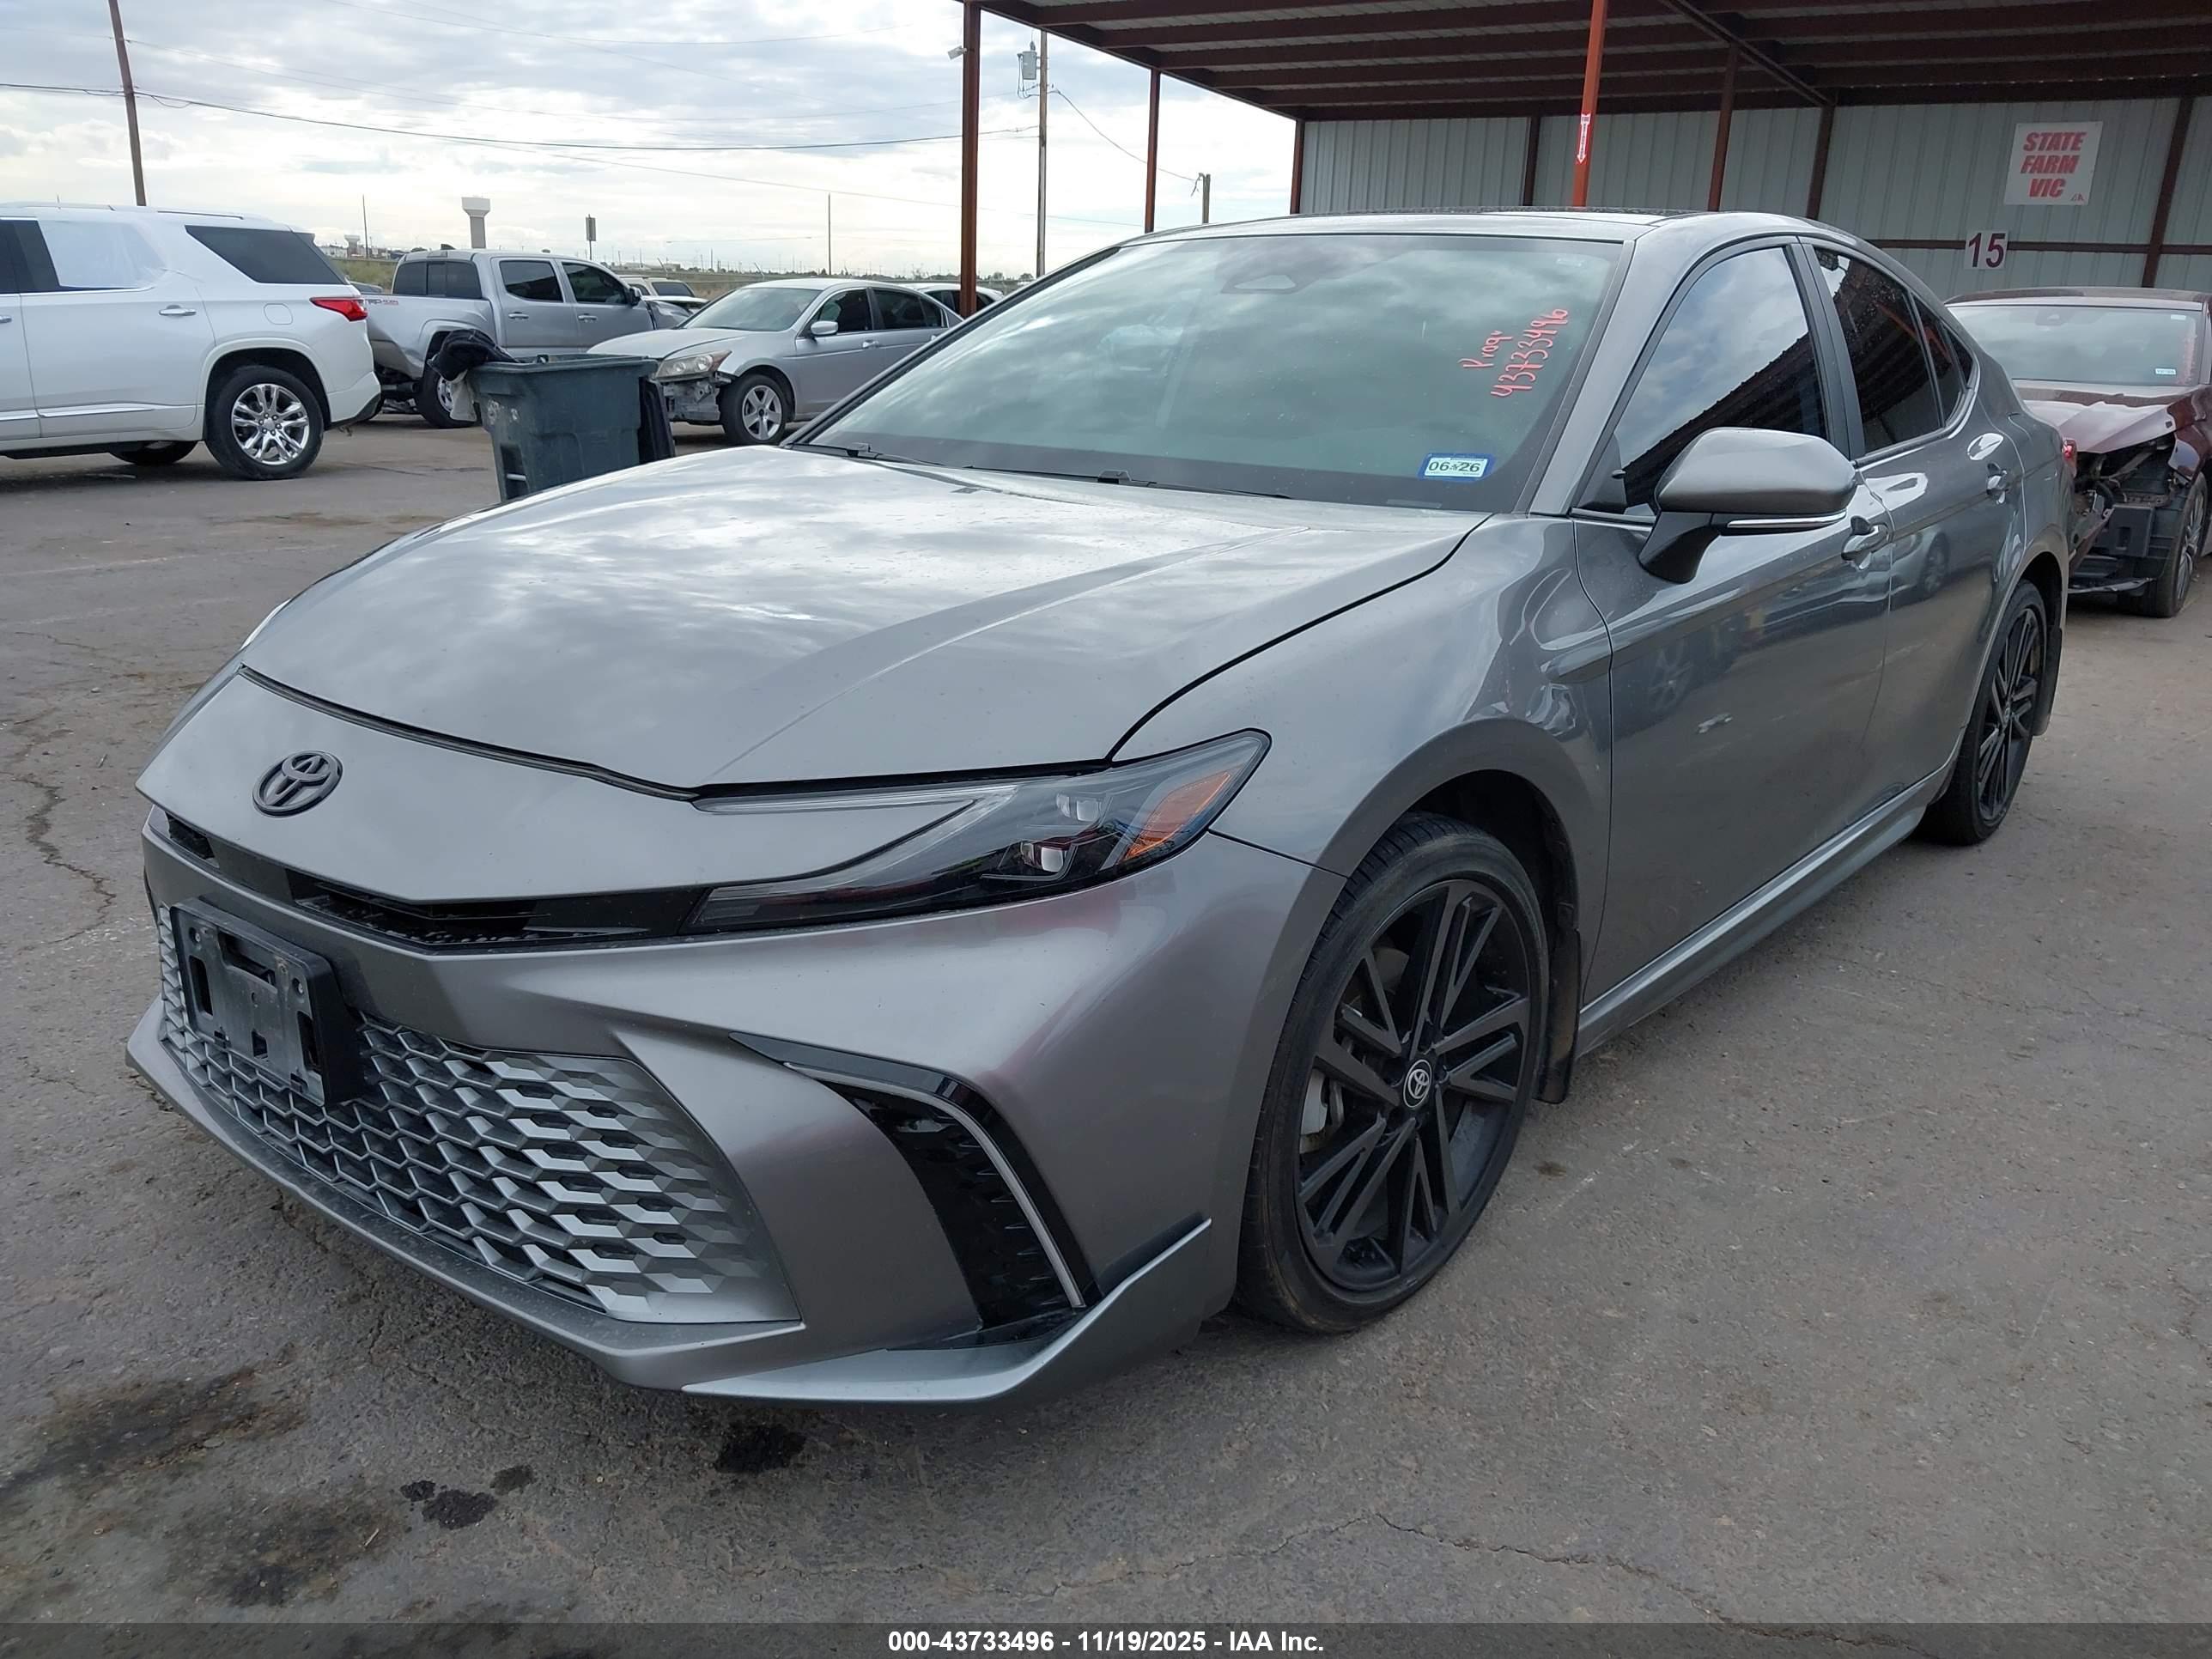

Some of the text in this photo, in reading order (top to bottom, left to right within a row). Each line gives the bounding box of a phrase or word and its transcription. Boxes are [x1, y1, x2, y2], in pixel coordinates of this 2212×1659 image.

[2023, 132, 2087, 152] STATE
[2021, 155, 2081, 174] FARM
[2029, 178, 2067, 198] VIC
[1968, 233, 2006, 268] 15
[1490, 308, 1570, 398] 43733496
[1428, 461, 1481, 472] 06 26
